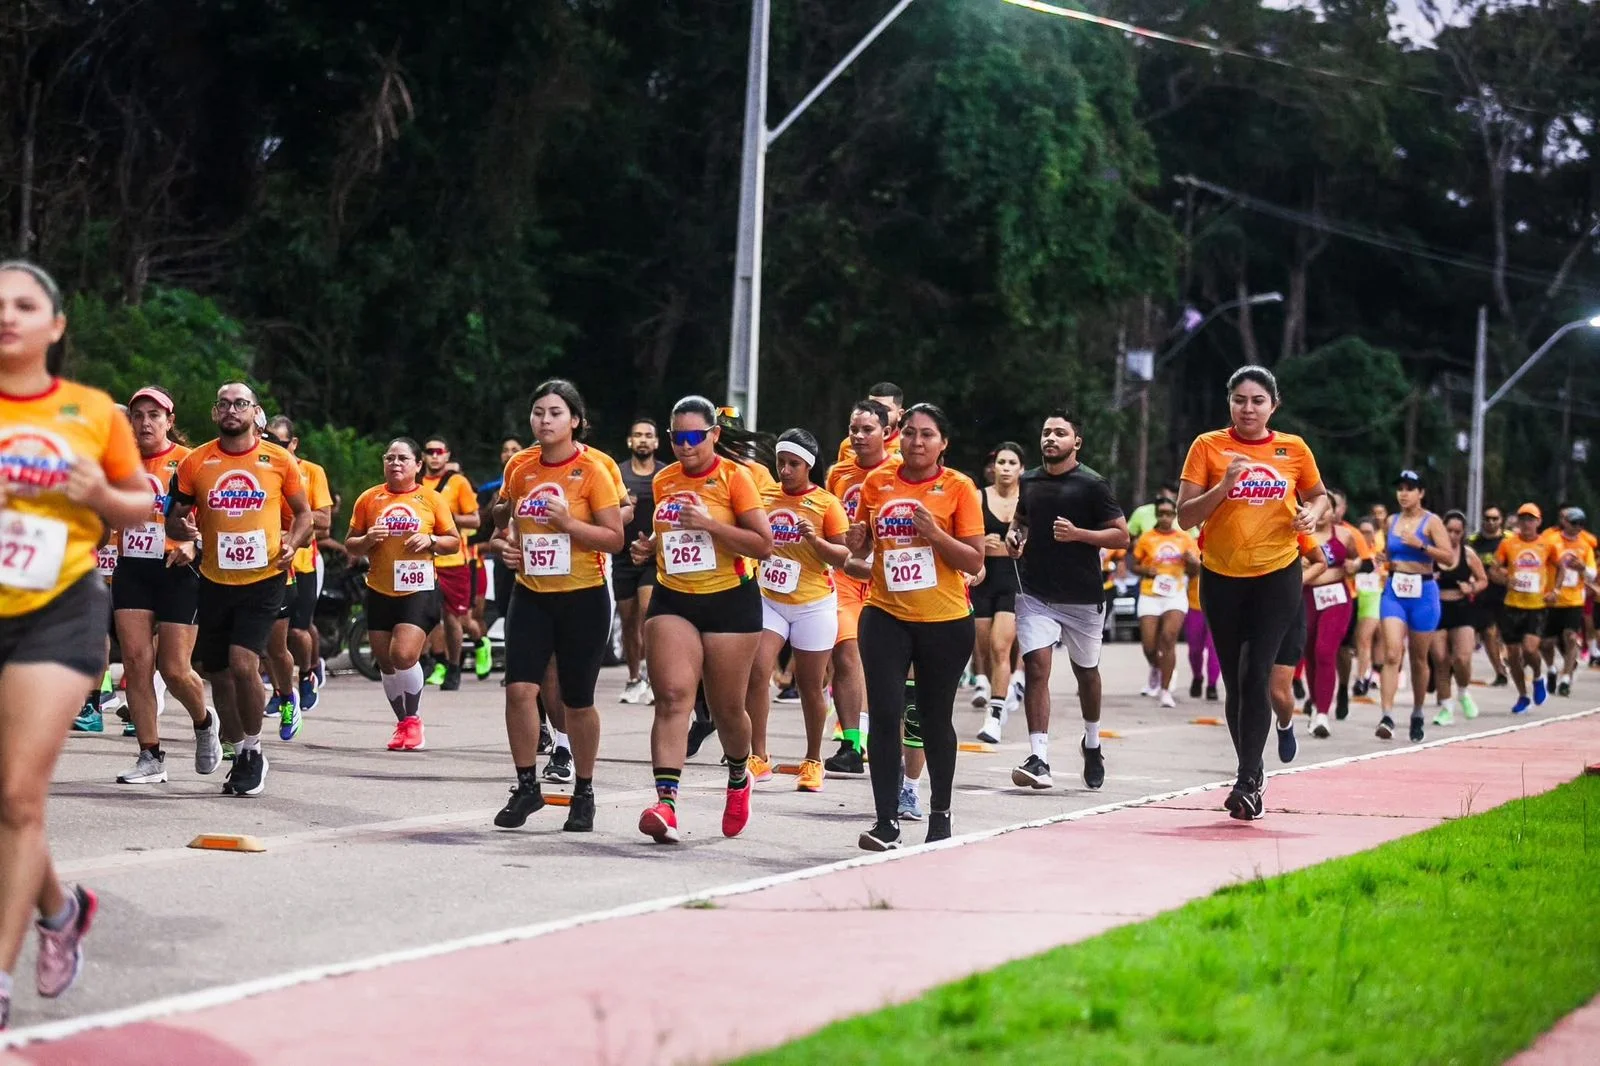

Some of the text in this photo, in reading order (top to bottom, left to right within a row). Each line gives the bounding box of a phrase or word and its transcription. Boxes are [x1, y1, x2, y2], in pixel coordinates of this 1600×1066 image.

[1228, 487, 1285, 498] CARIPI
[208, 497, 263, 509] CARIPI
[518, 506, 546, 516] CAR
[385, 522, 418, 531] ARIPI
[128, 535, 153, 550] 247
[0, 541, 36, 571] 27
[226, 546, 255, 562] 492
[529, 550, 556, 566] 357
[672, 546, 701, 564] 262
[401, 571, 424, 584] 498
[764, 568, 787, 585] 468
[891, 564, 922, 582] 202
